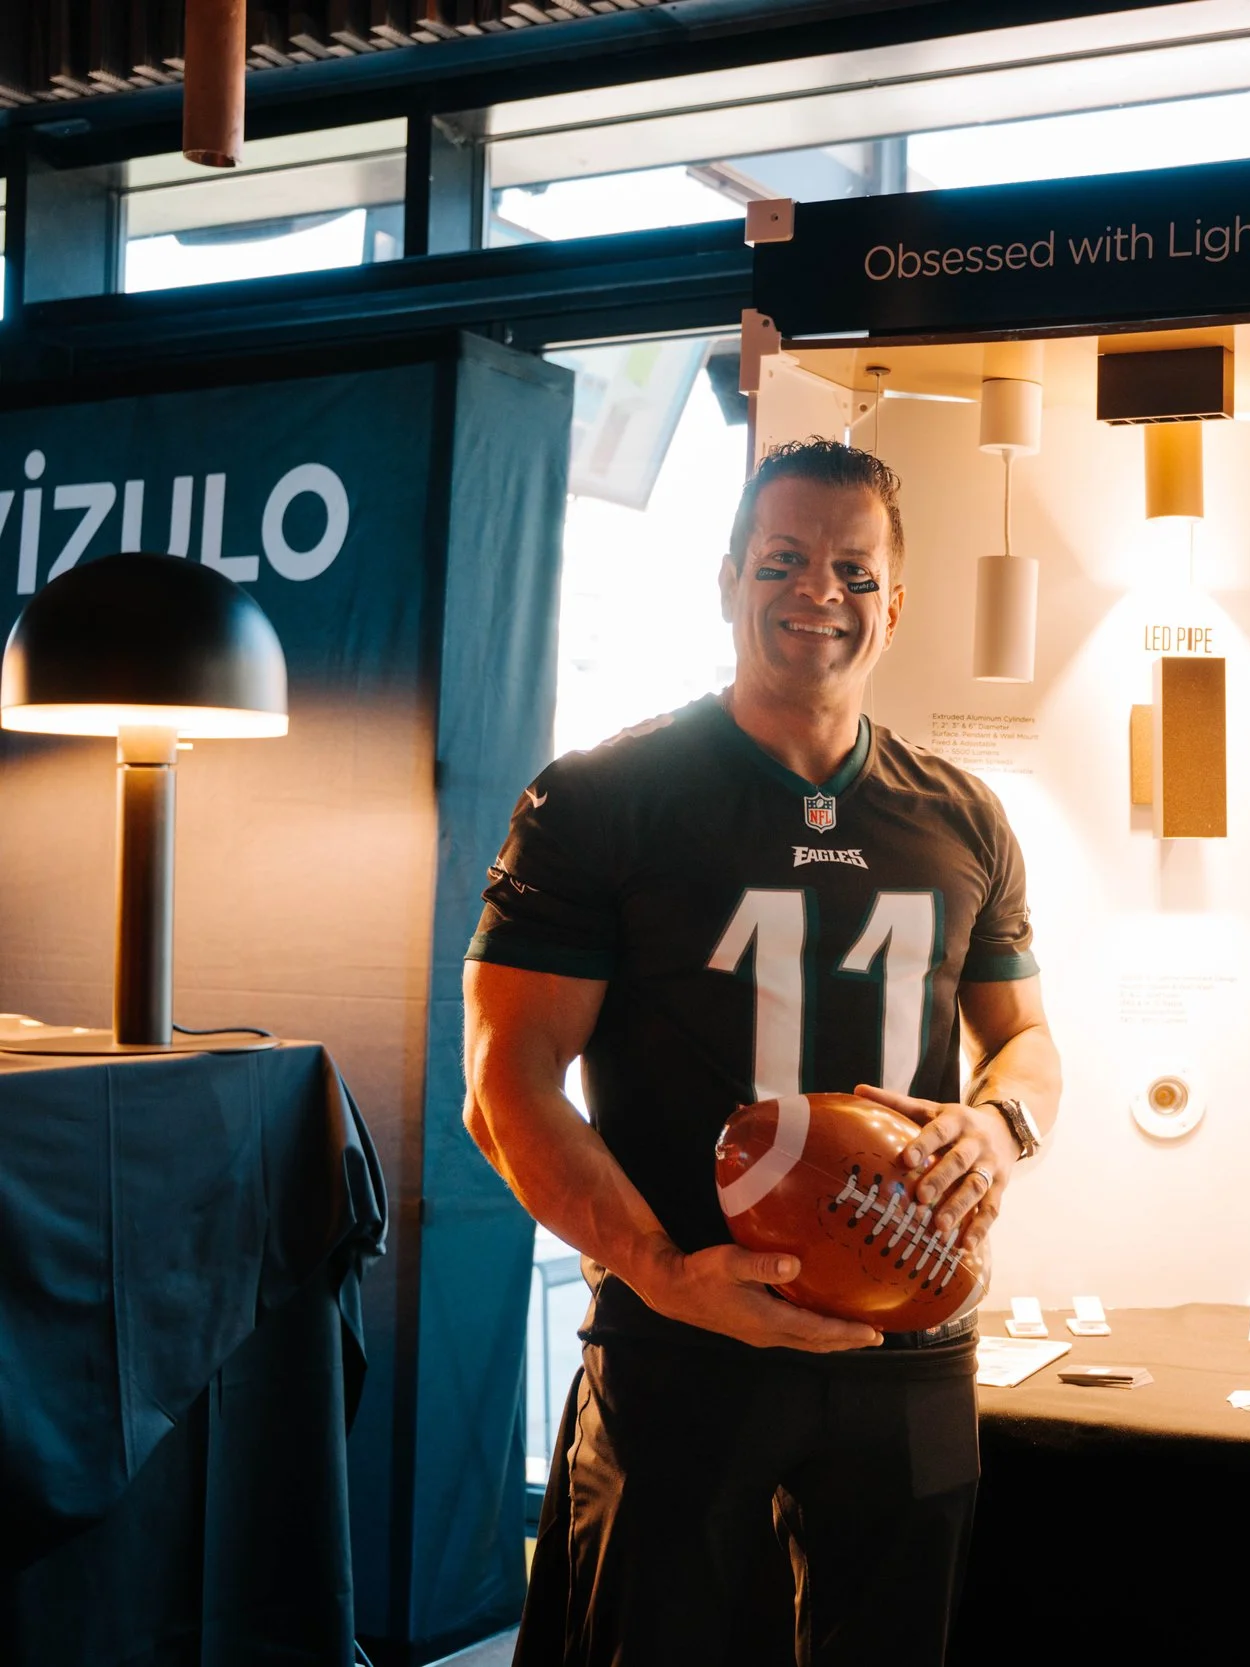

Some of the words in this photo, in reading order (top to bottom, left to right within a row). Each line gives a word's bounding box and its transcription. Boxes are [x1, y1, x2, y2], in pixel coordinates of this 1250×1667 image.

[864, 230, 1055, 281] Obsessed
[1068, 223, 1153, 265] with
[0, 449, 350, 595] iZULO
[1144, 625, 1171, 651] LED
[1176, 627, 1212, 653] PIPE
[1003, 715, 1035, 724] Cylinders
[810, 810, 832, 826] NFL
[791, 846, 869, 870] EAGLES
[704, 888, 943, 1102] 11
